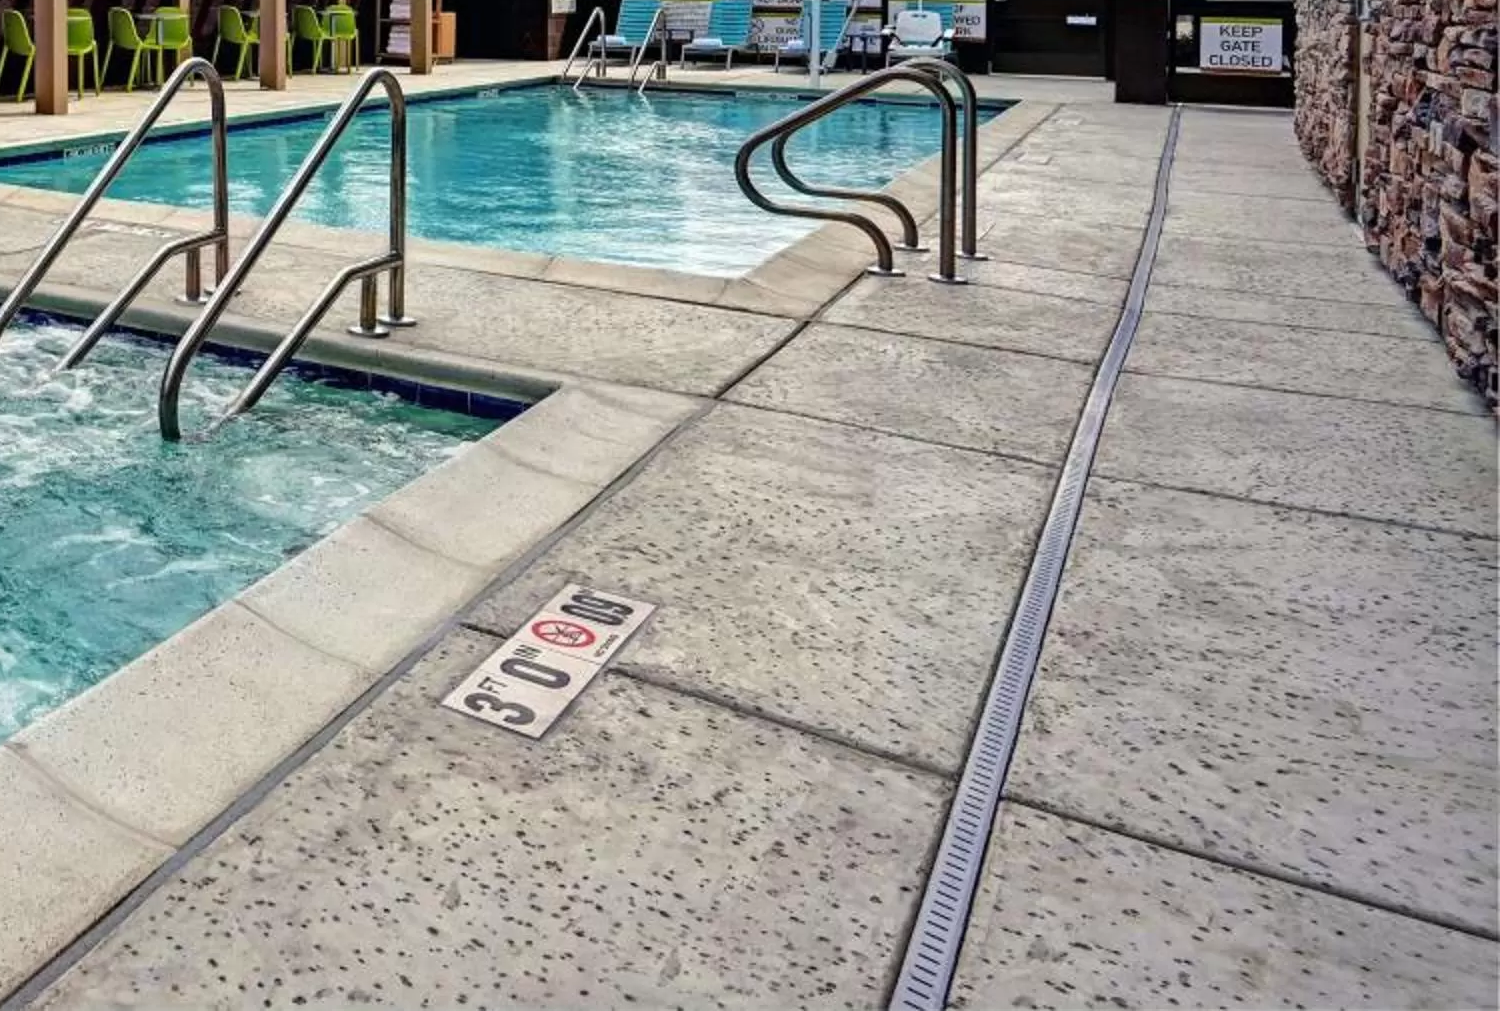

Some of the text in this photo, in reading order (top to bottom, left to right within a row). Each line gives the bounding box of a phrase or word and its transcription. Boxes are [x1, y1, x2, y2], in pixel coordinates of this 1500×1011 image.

[1220, 26, 1262, 37] KEEP
[1220, 41, 1262, 52] GATE
[1210, 55, 1272, 67] CLOSED
